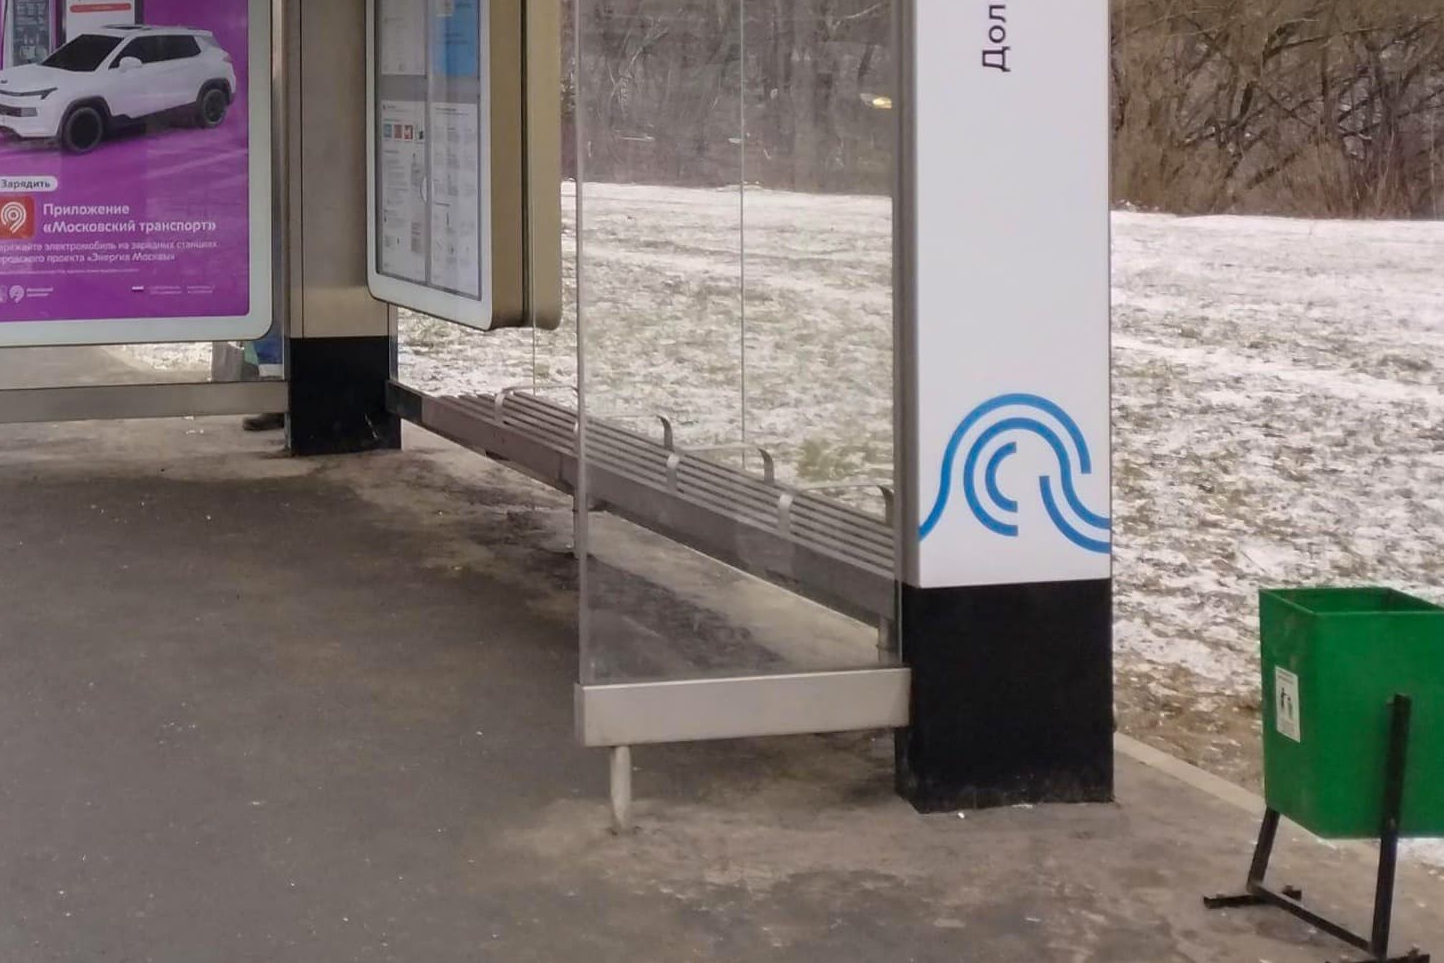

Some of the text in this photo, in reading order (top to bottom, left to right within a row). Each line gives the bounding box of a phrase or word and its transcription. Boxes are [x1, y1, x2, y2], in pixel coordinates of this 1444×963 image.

[1, 179, 51, 190] Зарядить
[43, 203, 131, 217] Приложение
[43, 220, 217, 234] «Московский транспорт»
